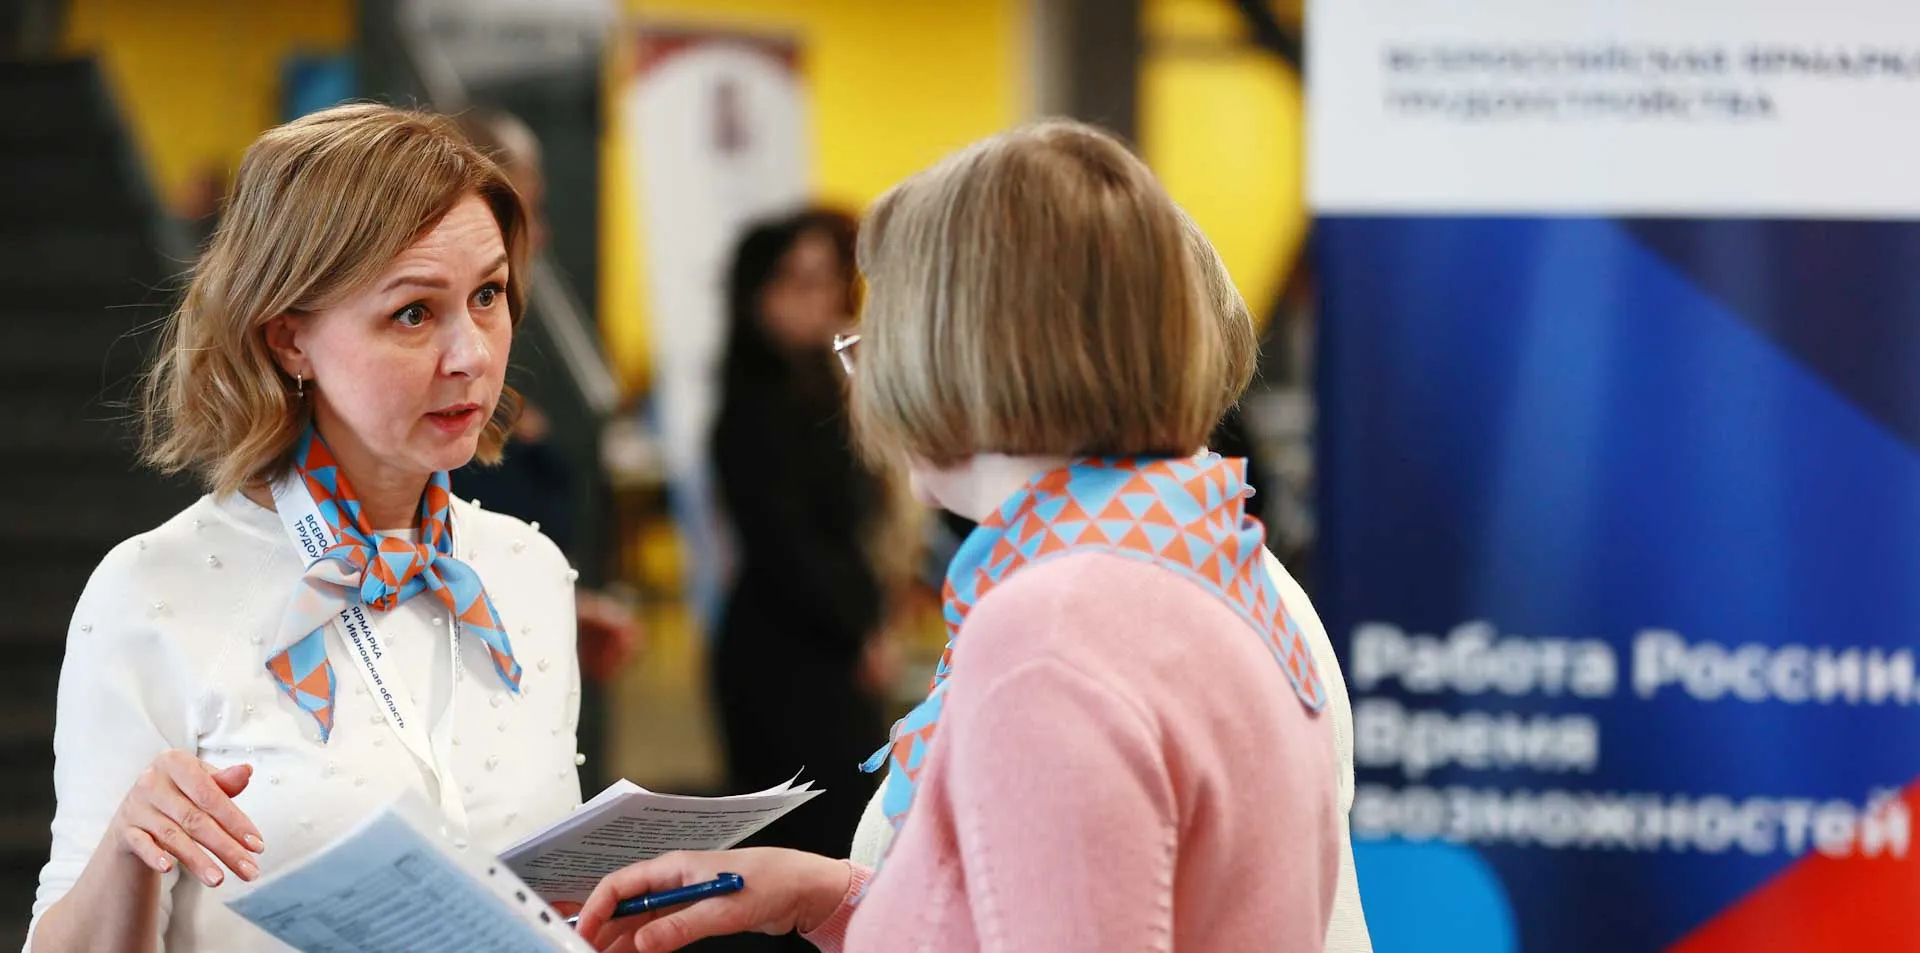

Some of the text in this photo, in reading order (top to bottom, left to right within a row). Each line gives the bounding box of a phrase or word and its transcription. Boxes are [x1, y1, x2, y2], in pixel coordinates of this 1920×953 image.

[294, 520, 320, 558] ТРУДОУ
[346, 623, 382, 685] Ивановская
[380, 687, 404, 729] область
[352, 606, 383, 659] ЯРМАРКА
[1353, 623, 1616, 694] Работа
[1355, 699, 1596, 774] Время
[1355, 784, 1909, 856] возможностей
